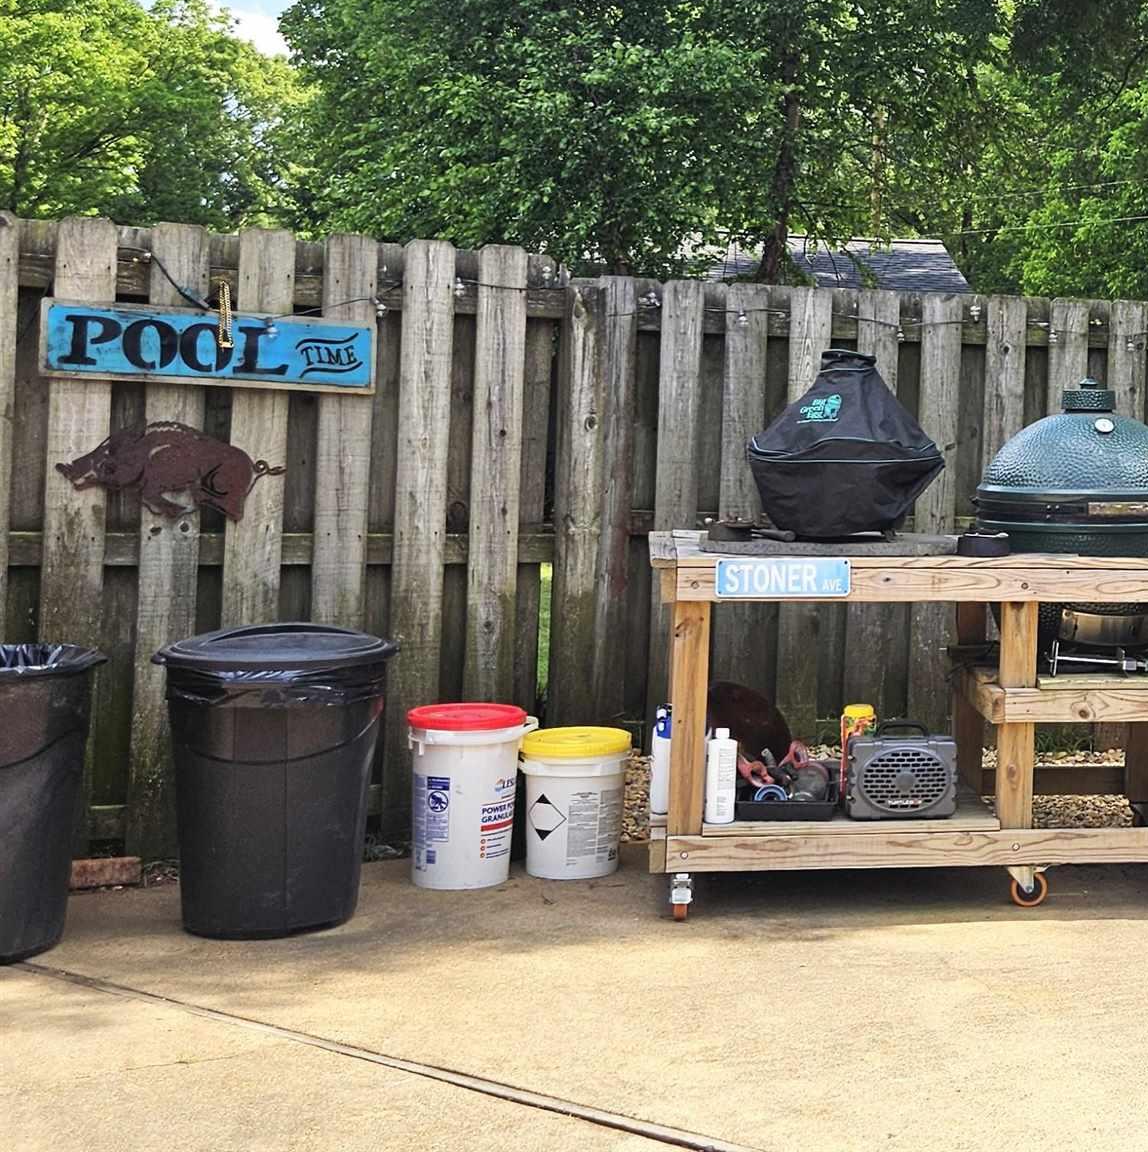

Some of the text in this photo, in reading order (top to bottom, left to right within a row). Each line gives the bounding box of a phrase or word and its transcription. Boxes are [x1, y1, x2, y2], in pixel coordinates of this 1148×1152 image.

[57, 314, 358, 376] POOL TIME
[725, 564, 842, 593] STONER AVE
